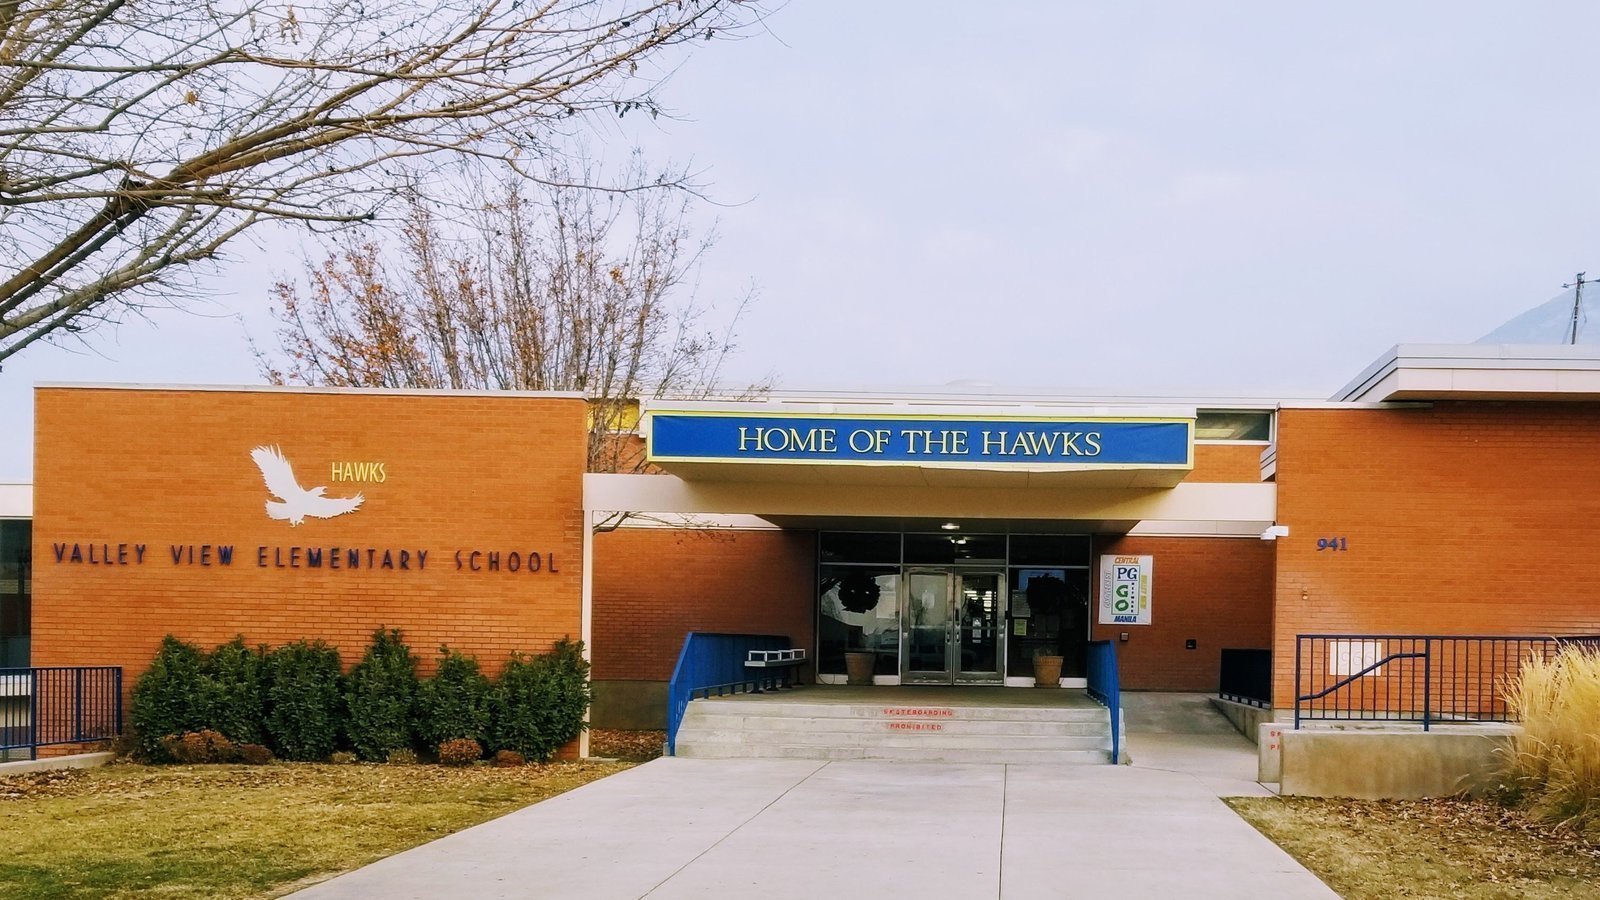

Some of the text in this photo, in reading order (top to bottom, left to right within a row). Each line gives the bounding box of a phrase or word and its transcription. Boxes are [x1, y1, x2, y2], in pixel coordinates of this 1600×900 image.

[738, 427, 1102, 457] HOME OF THE HAWKS
[331, 461, 386, 483] HAWKS
[1316, 537, 1348, 551] 941
[54, 543, 559, 573] VALLEY VIEW ELEMENTARY SCHOOL
[1117, 567, 1138, 580] PG
[883, 708, 953, 716] SKATEBOARDING
